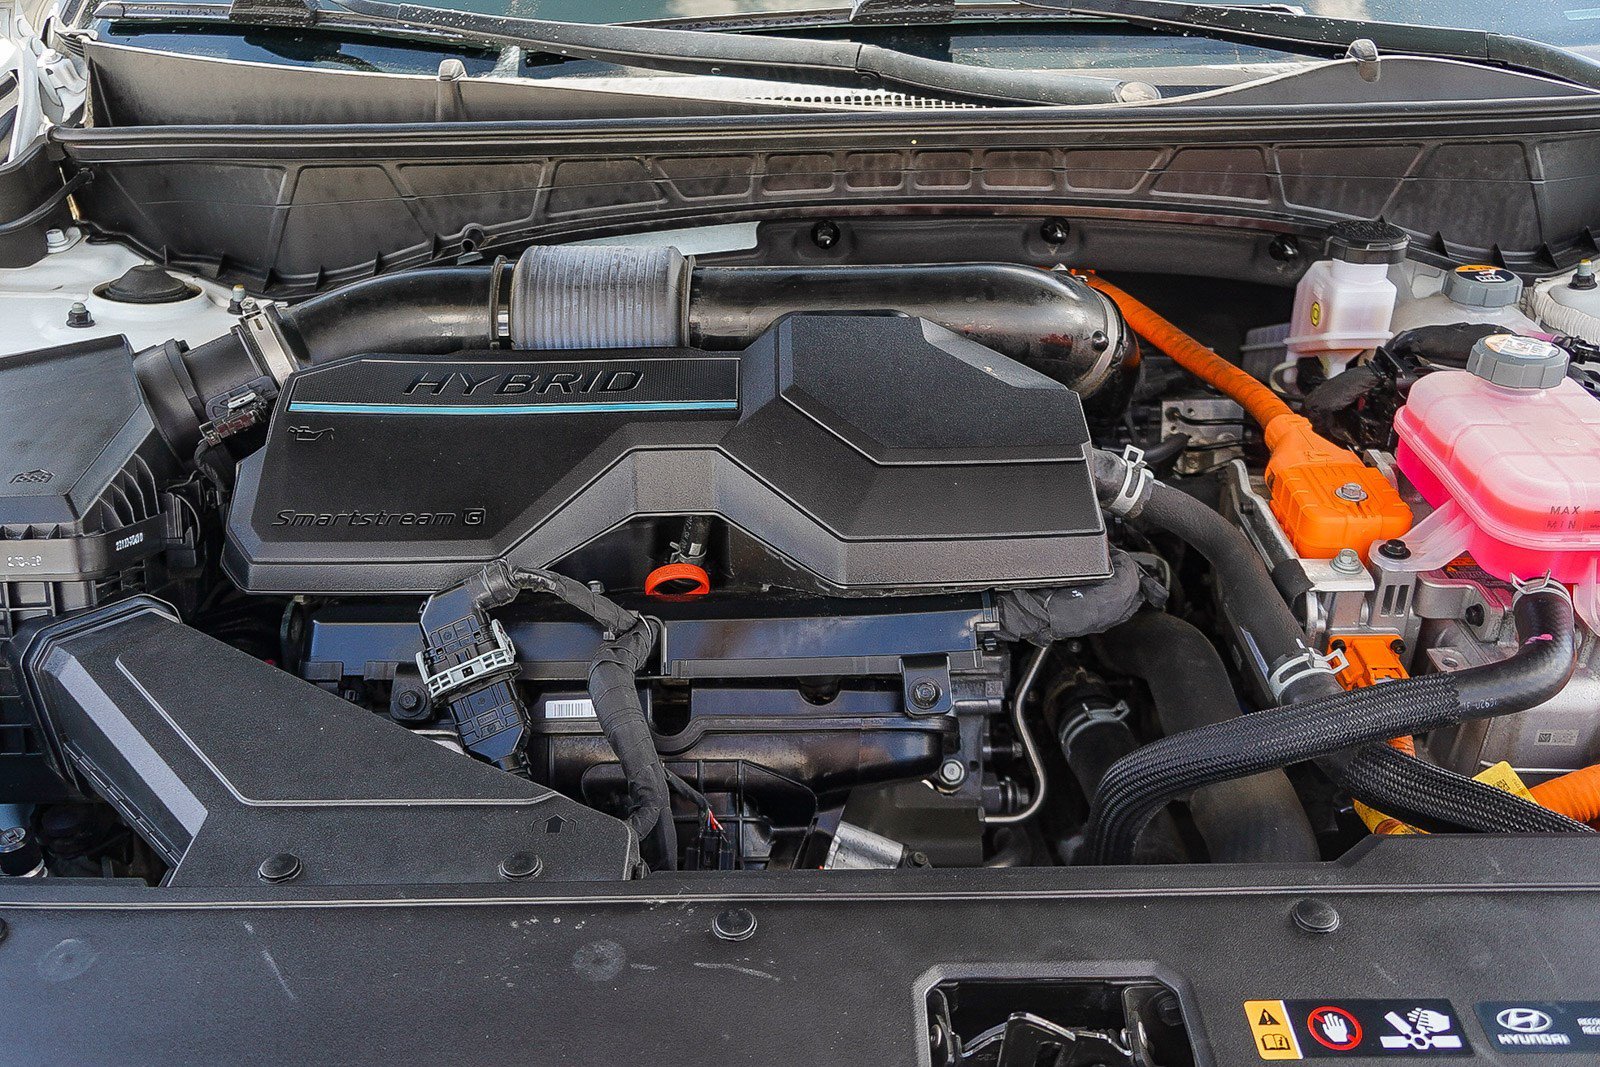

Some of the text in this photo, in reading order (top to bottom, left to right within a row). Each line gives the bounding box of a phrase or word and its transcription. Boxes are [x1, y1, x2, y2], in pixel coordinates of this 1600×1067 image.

[402, 370, 644, 395] HYBRID
[1550, 505, 1581, 515] MAX
[271, 509, 457, 526] Smartstream
[1546, 520, 1577, 529] MIN
[1497, 1033, 1571, 1045] HYUNDAI
